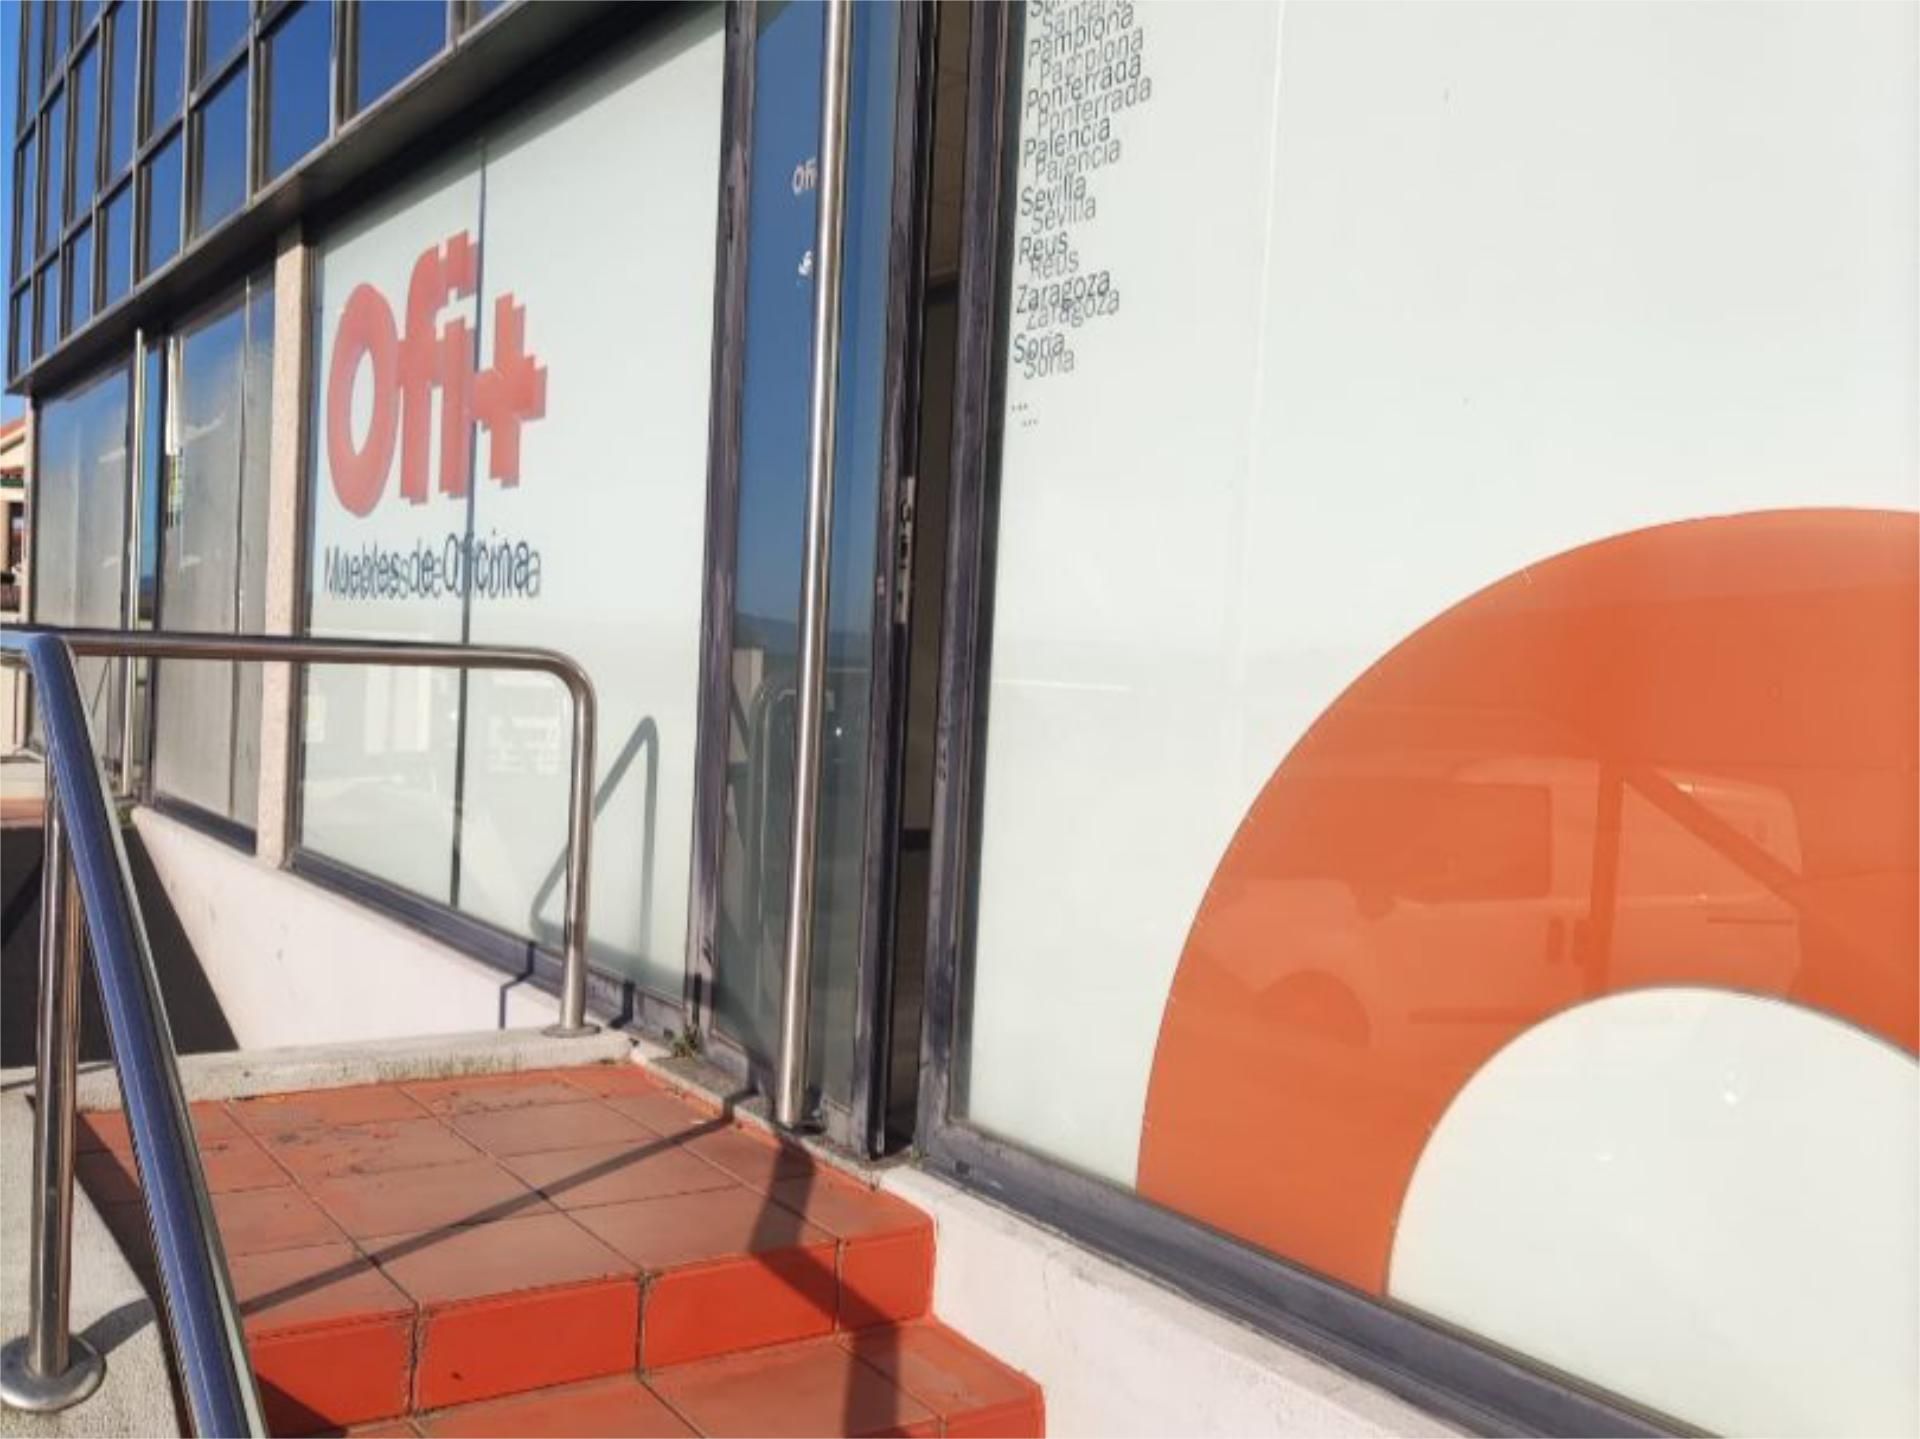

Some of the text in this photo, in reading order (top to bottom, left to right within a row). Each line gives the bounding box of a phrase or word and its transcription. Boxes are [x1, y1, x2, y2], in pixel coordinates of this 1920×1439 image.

[1028, 4, 1133, 69] Pamplona
[1026, 53, 1141, 120] Ponferrada
[1024, 117, 1110, 168] Palencia
[1021, 175, 1087, 216] Sevilla
[1019, 231, 1068, 265] Reus
[1016, 270, 1110, 315] Zaragoza
[1013, 331, 1065, 364] Soria
[325, 528, 531, 593] Muebles de Oficina
